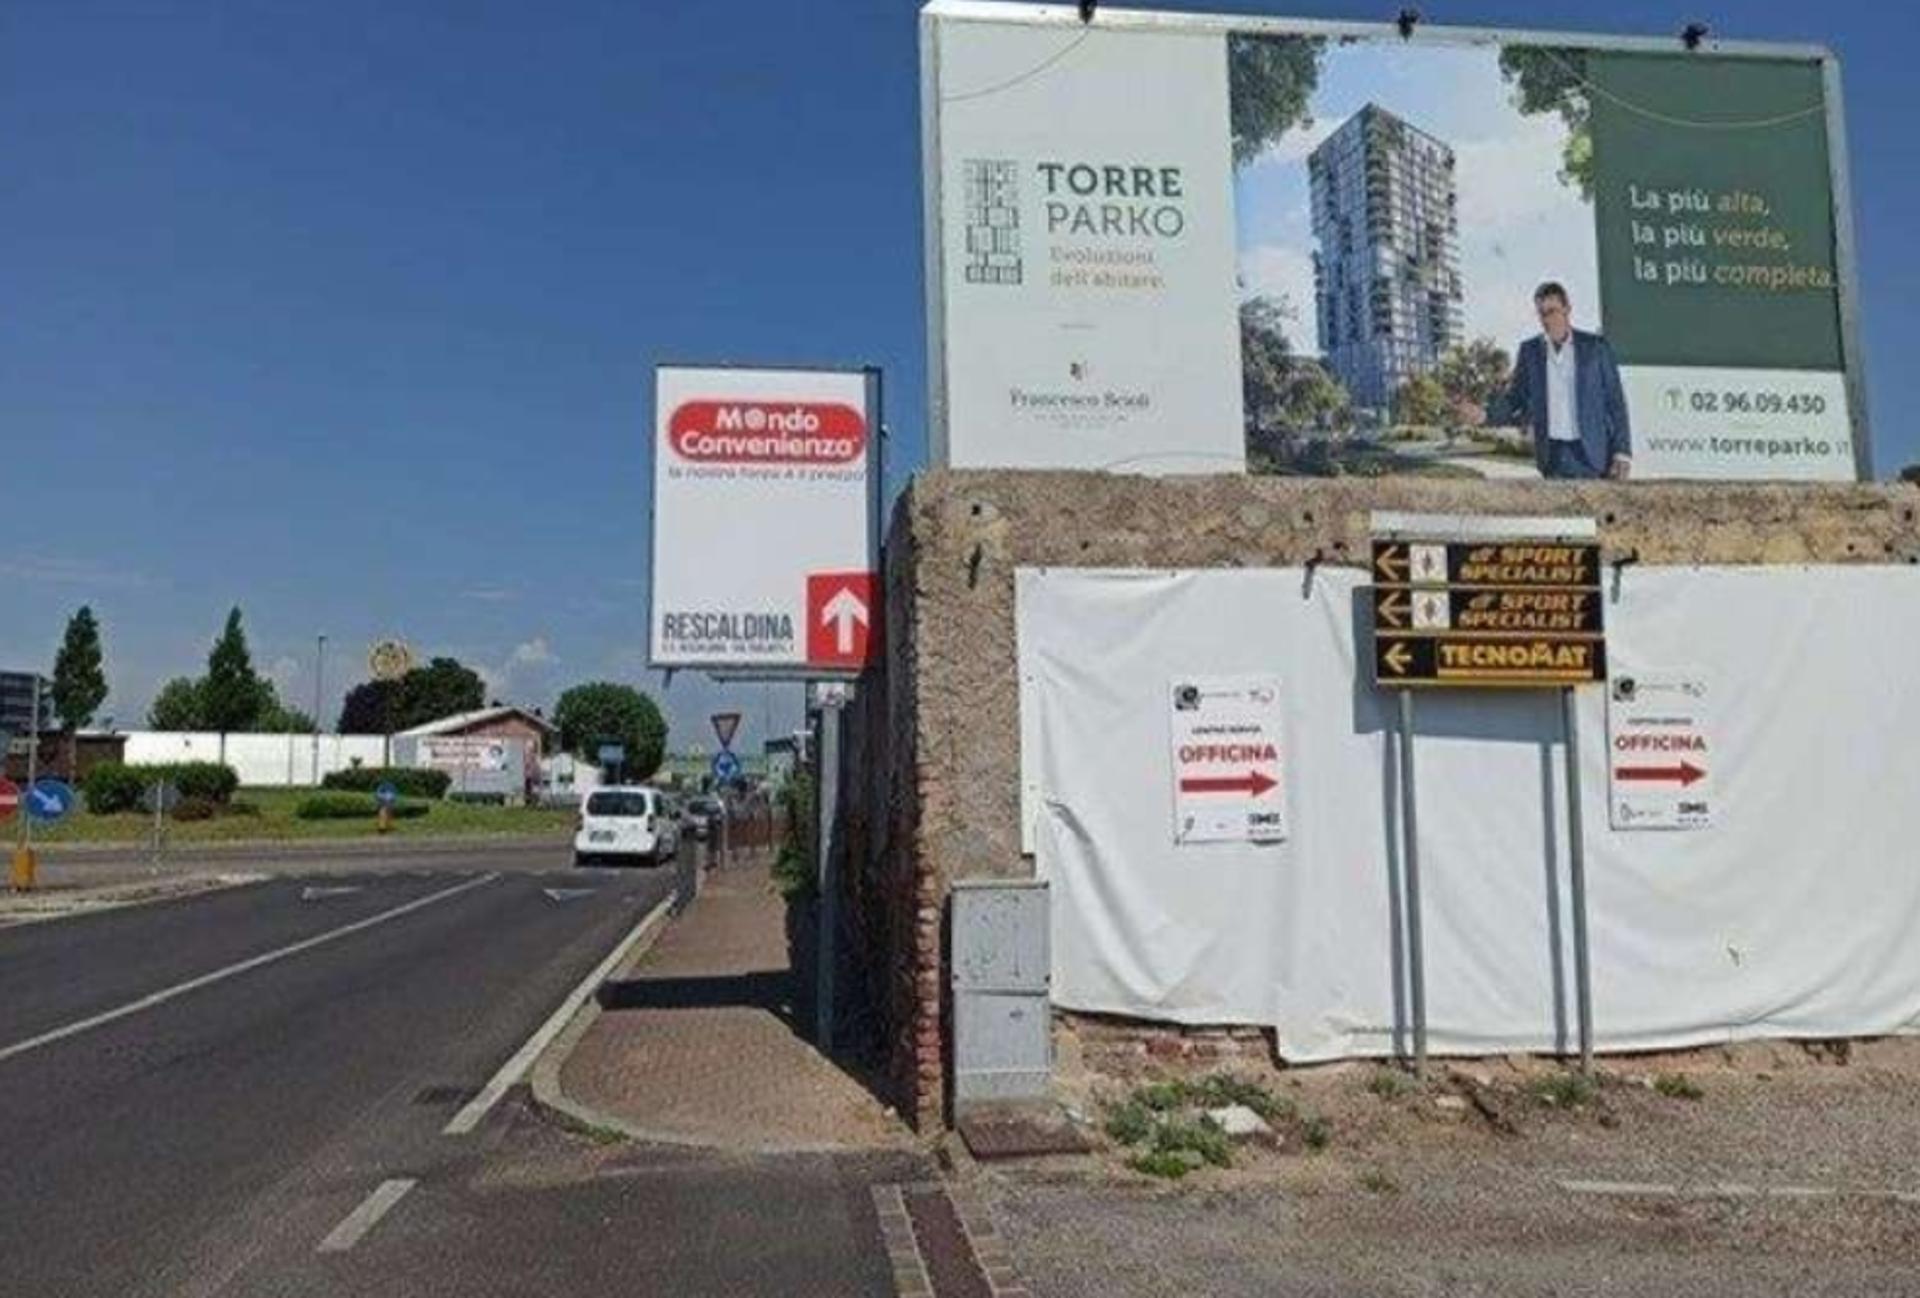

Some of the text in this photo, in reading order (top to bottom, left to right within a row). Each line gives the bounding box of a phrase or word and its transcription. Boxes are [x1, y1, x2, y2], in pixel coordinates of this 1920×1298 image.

[1037, 163, 1183, 197] TORRE
[1630, 184, 1660, 208] La
[1668, 188, 1710, 214] più
[1045, 201, 1184, 238] PARKO
[1631, 220, 1791, 250] la più verde,
[1634, 255, 1657, 280] la
[1667, 257, 1708, 286] più
[1691, 392, 1719, 411] 02
[679, 431, 854, 457] Convenienza
[1500, 547, 1586, 564] SPORT
[1459, 565, 1587, 581] SPECIALIST
[1500, 593, 1586, 610] SPORT
[662, 612, 794, 641] RESCALDINA
[1459, 612, 1587, 628] SPECIALIST
[1441, 643, 1588, 666] TECNOMAT
[1179, 743, 1278, 764] OFFICINA
[1614, 735, 1707, 752] OFFICINA
